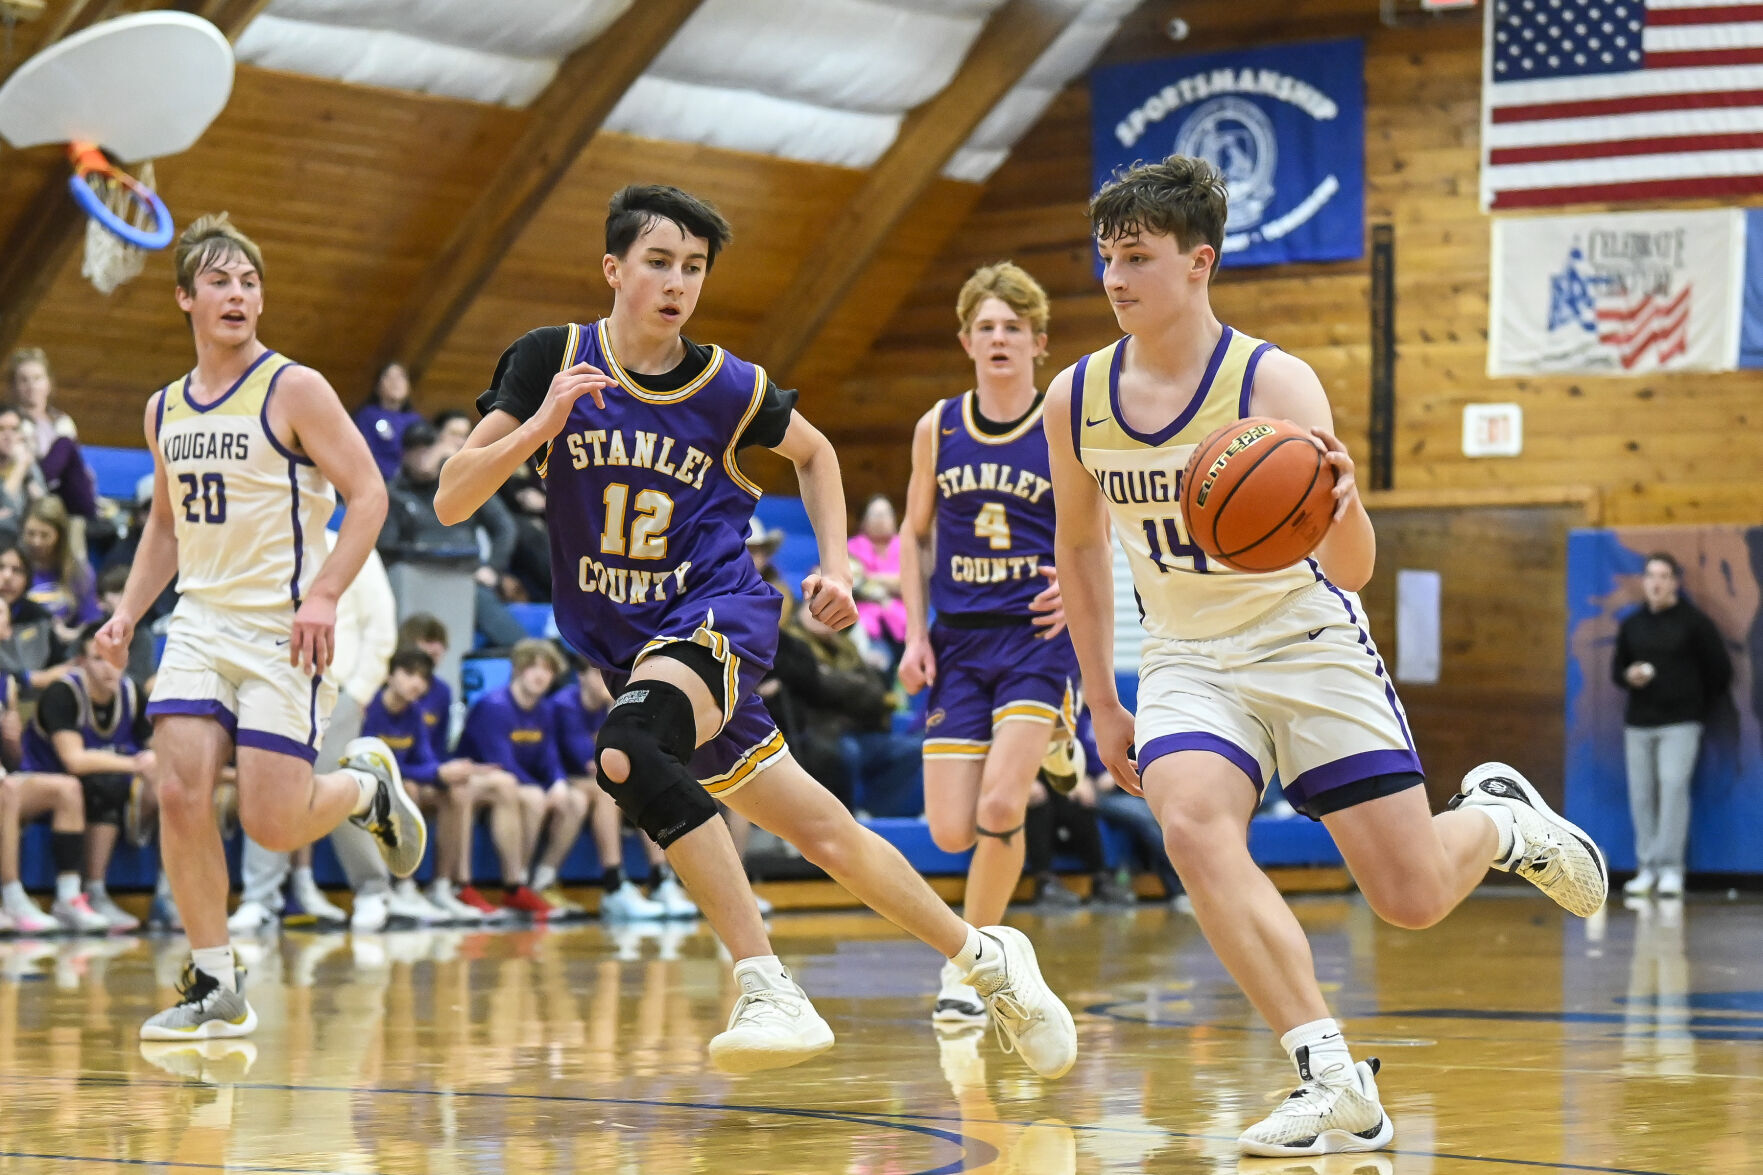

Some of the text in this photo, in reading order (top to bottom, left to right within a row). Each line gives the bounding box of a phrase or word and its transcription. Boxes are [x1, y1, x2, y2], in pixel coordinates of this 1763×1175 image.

[164, 432, 249, 464] KOUGARS
[566, 429, 713, 490] STANLEY
[178, 472, 226, 524] 20
[937, 463, 1051, 504] STANLEY
[1093, 468, 1184, 504] KOUG
[600, 482, 674, 560] 12
[974, 502, 1011, 550] 4
[950, 555, 1039, 583] COUNTY
[1142, 518, 1209, 573] 14
[578, 556, 692, 604] COUNTY
